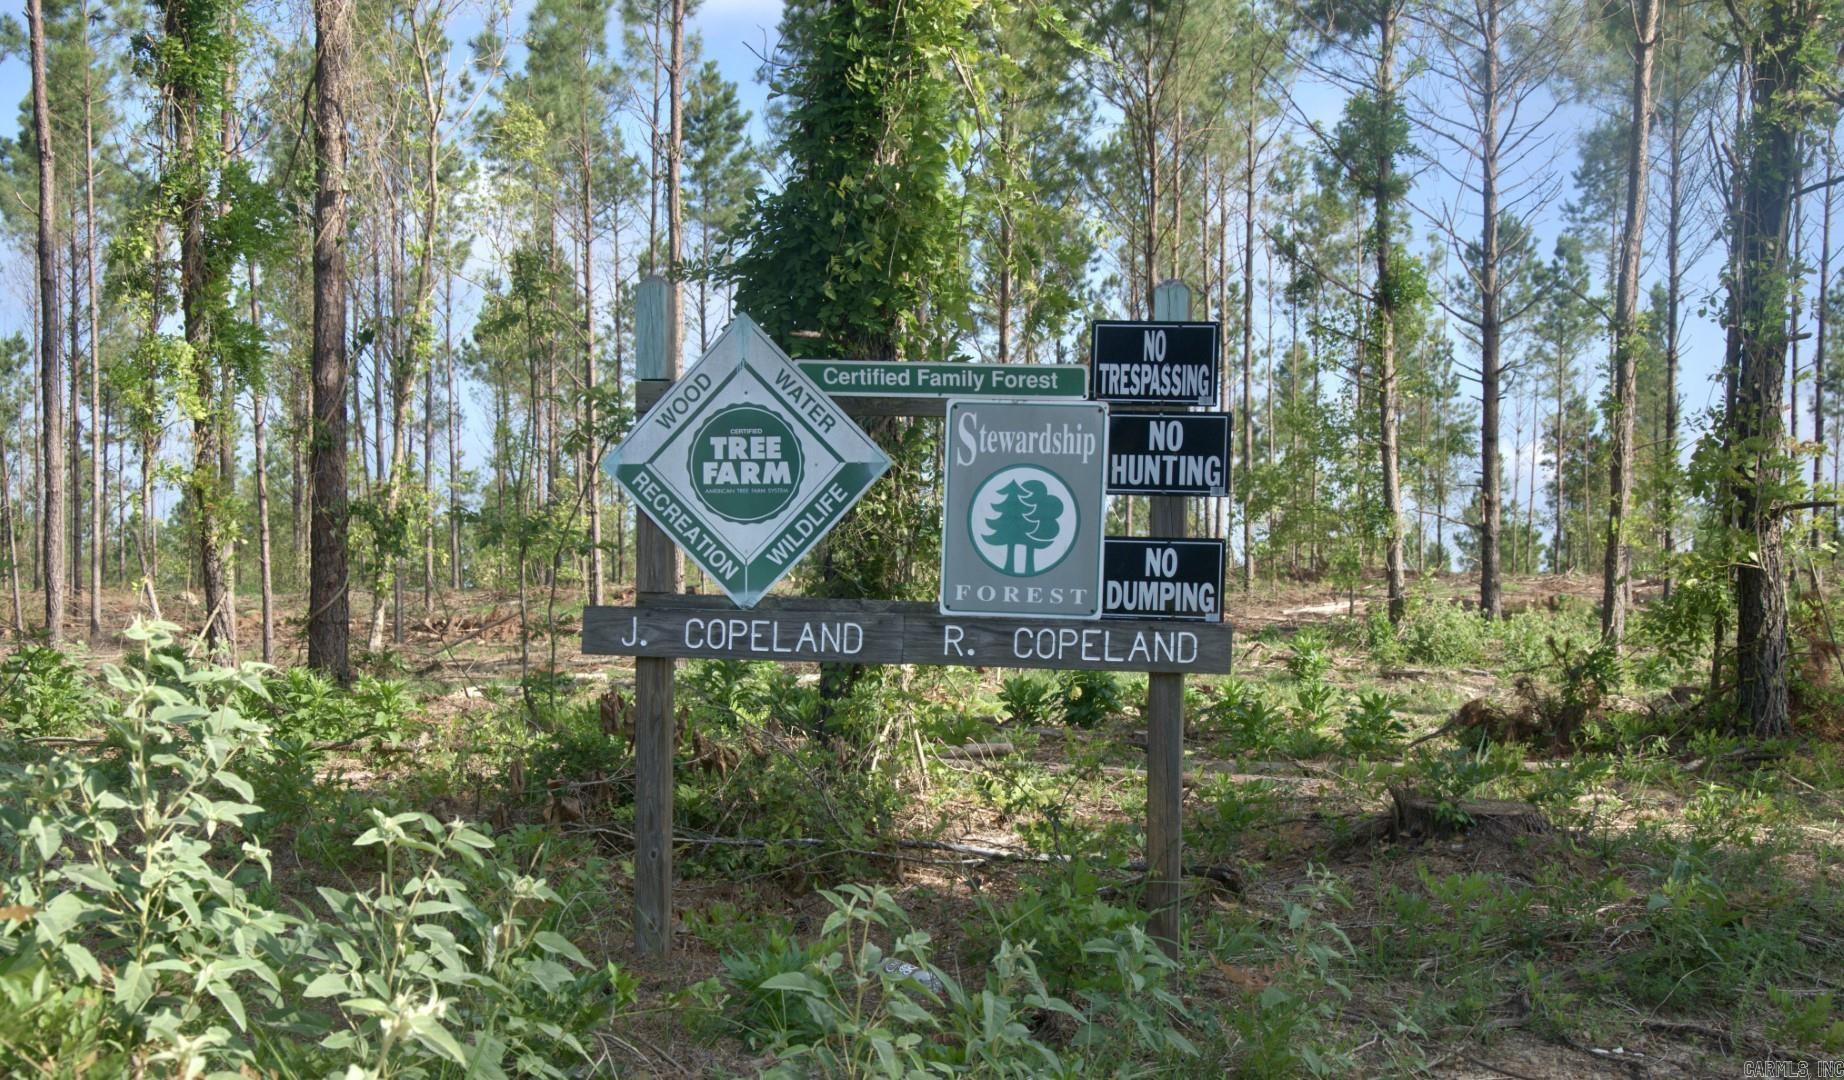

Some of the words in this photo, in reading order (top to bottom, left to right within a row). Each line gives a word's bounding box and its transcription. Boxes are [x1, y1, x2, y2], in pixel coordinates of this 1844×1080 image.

[1143, 329, 1167, 362] NO
[823, 367, 910, 386] Certified
[917, 369, 984, 391] Family
[991, 371, 1059, 389] Forest
[1098, 362, 1210, 396] TRESPASSING
[655, 372, 712, 431] WOOD
[774, 368, 837, 434] WATER
[710, 436, 782, 460] TREE
[956, 412, 1096, 466] Stewardship
[1149, 420, 1184, 451] NO
[703, 461, 792, 485] FARM
[1111, 454, 1221, 487] HUNTING
[631, 471, 740, 581] RECREATION
[765, 482, 849, 567] WILDLIFE
[1145, 547, 1178, 578] NO
[955, 584, 1088, 605] FOREST
[1106, 580, 1215, 614] DUMPING
[621, 616, 647, 647] J.
[684, 617, 863, 654] COPELAND
[944, 624, 975, 657] R.
[1013, 627, 1198, 664] COPELAND
